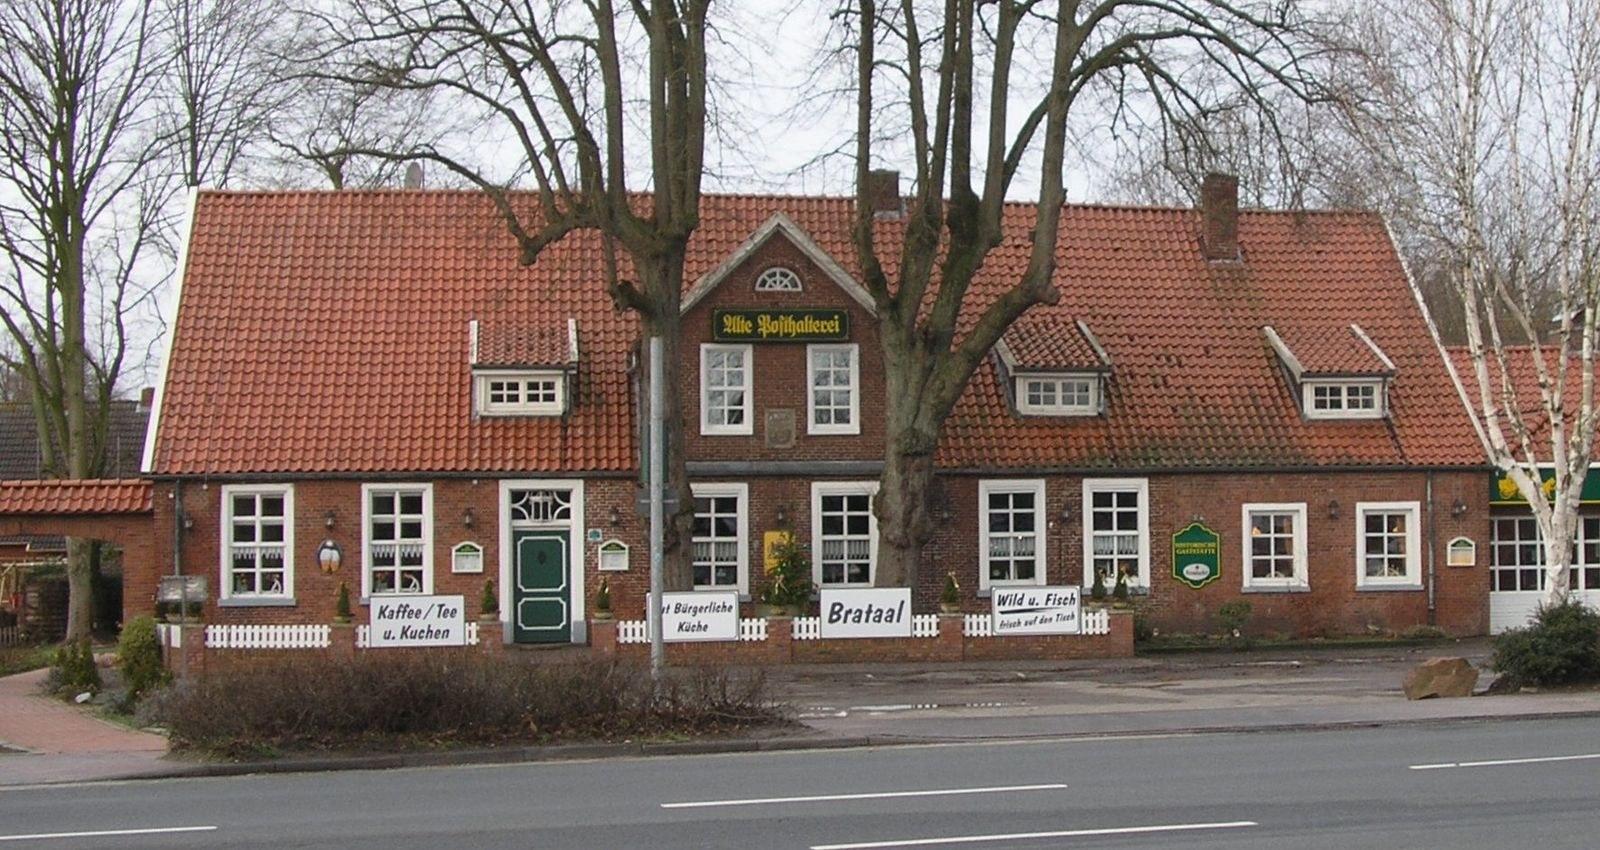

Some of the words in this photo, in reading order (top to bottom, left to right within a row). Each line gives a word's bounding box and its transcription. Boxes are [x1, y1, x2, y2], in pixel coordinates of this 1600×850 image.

[723, 314, 753, 334] Alte
[997, 593, 1025, 606] Wild
[1028, 597, 1040, 606] u.
[1045, 592, 1076, 606] Fisch
[378, 603, 422, 620] Kaffee
[436, 603, 458, 619] Tee
[674, 601, 733, 617] Bürgerliche
[828, 600, 905, 624] Brataal
[677, 620, 709, 633] Küche
[1024, 615, 1038, 627] auf
[1056, 611, 1075, 622] Tisch
[383, 629, 396, 640] u.
[400, 624, 450, 640] Kuchen
